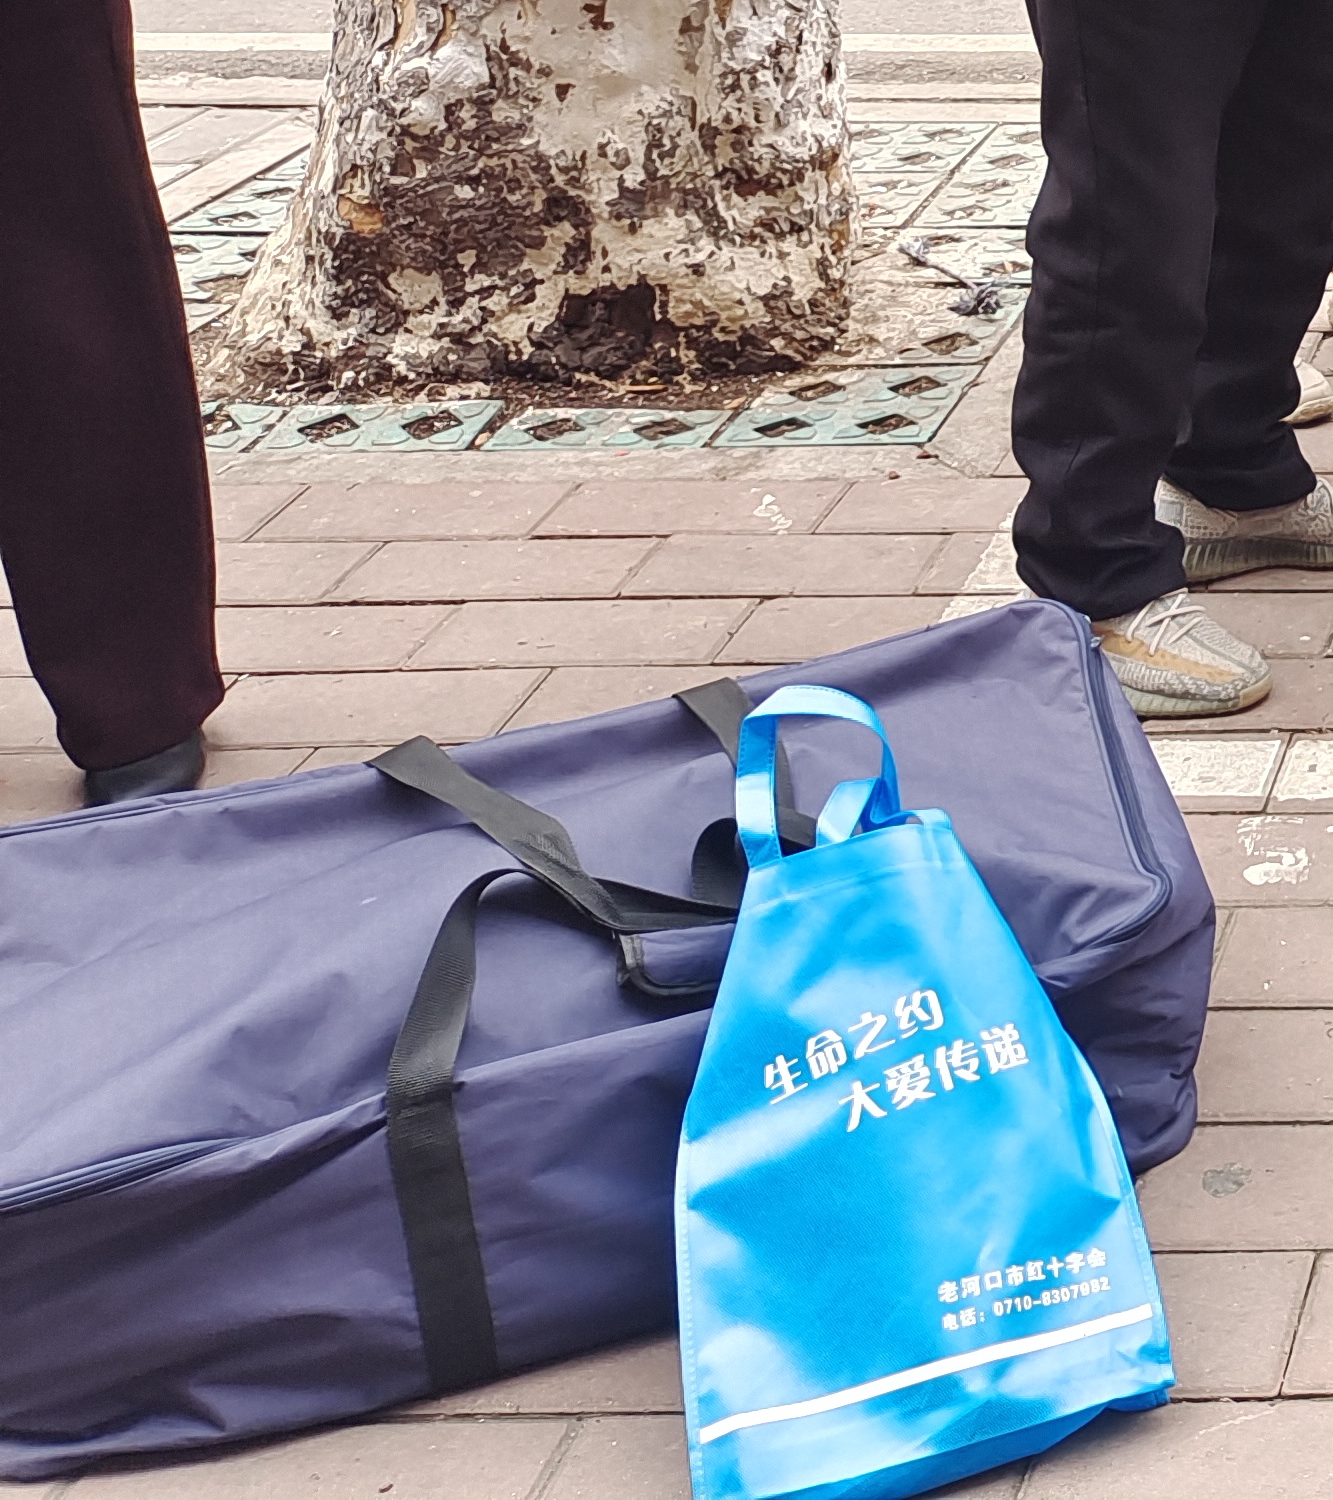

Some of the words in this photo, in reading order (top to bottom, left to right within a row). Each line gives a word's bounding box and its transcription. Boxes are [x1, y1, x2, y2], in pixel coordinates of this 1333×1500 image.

[763, 988, 945, 1105] 生命之约
[837, 1022, 1030, 1133] 大爱传递
[937, 1247, 1107, 1303] 老河口市红十字会
